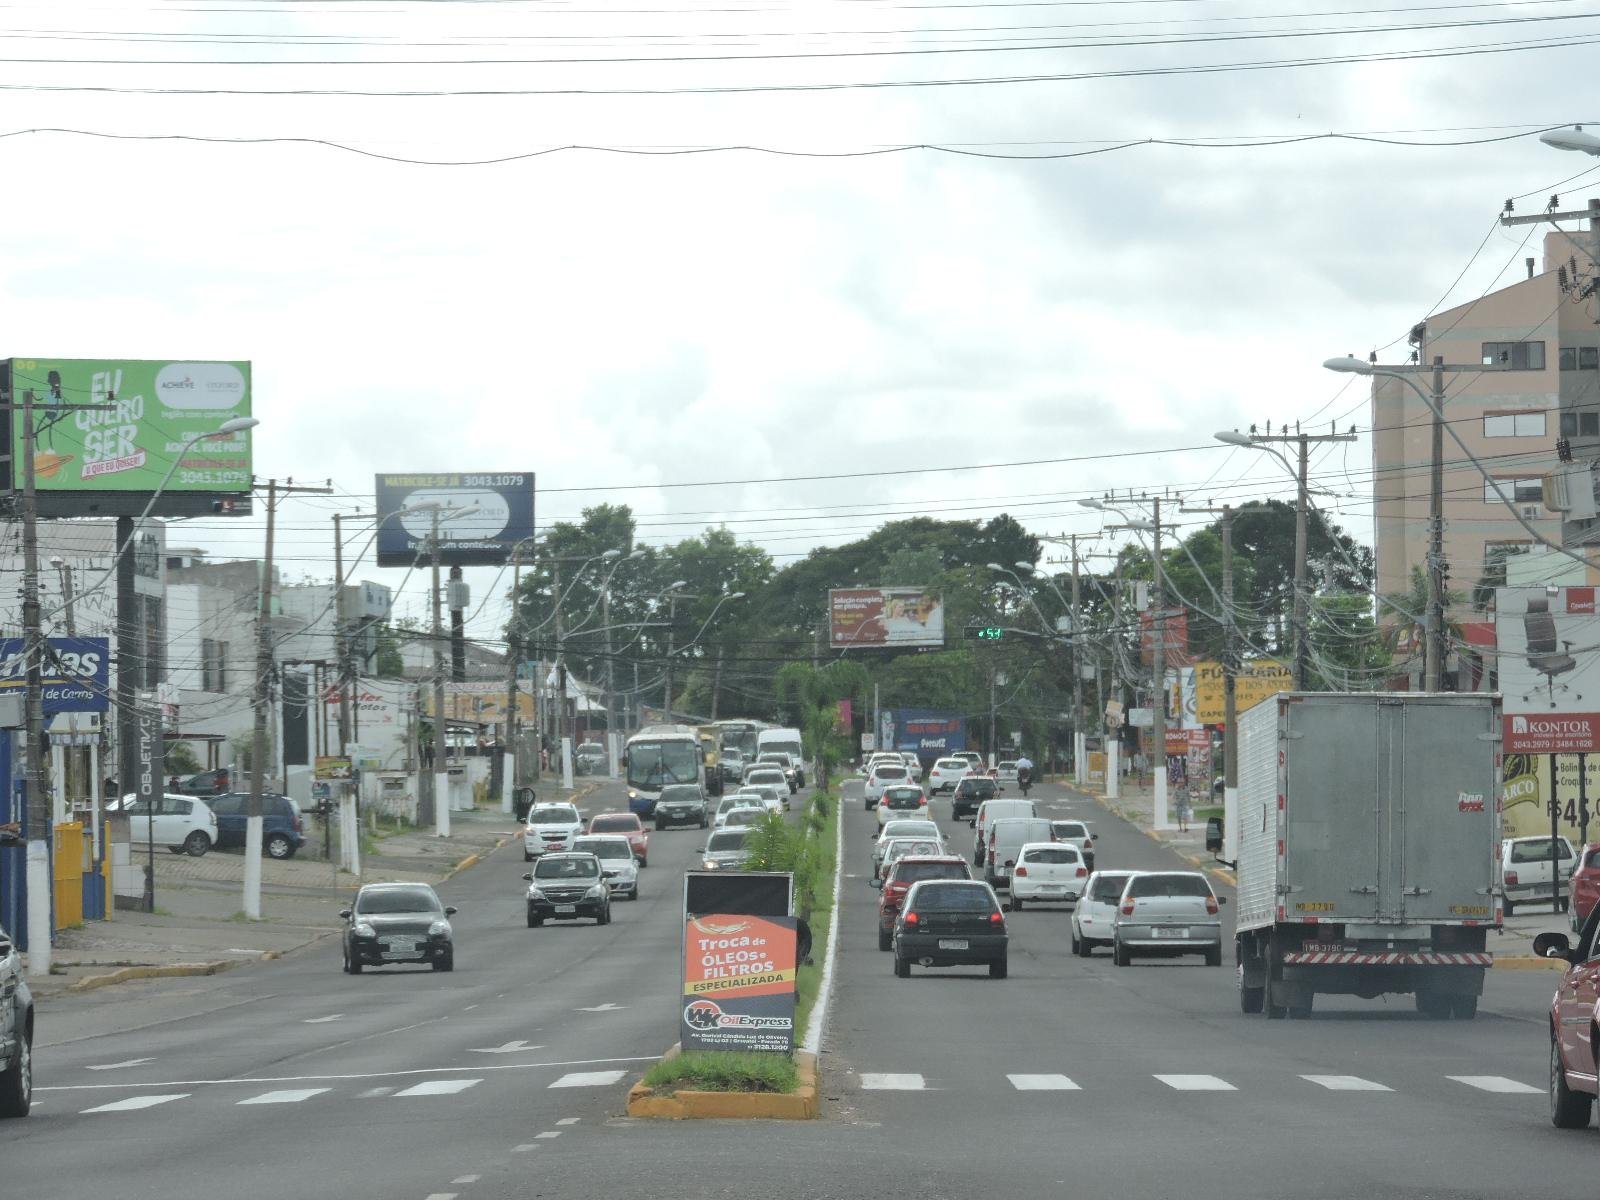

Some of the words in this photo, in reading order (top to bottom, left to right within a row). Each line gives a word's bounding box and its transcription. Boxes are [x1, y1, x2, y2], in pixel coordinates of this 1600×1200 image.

[91, 368, 122, 403] EU
[75, 394, 144, 432] QUERO
[82, 424, 138, 463] SER
[463, 475, 524, 487] 3043.1079
[46, 688, 60, 699] de
[1529, 721, 1591, 733] KONTOR
[699, 936, 750, 951] Troca
[752, 938, 766, 946] de
[703, 960, 774, 980] FILTROS
[693, 974, 784, 992] ESPECIALIZADA
